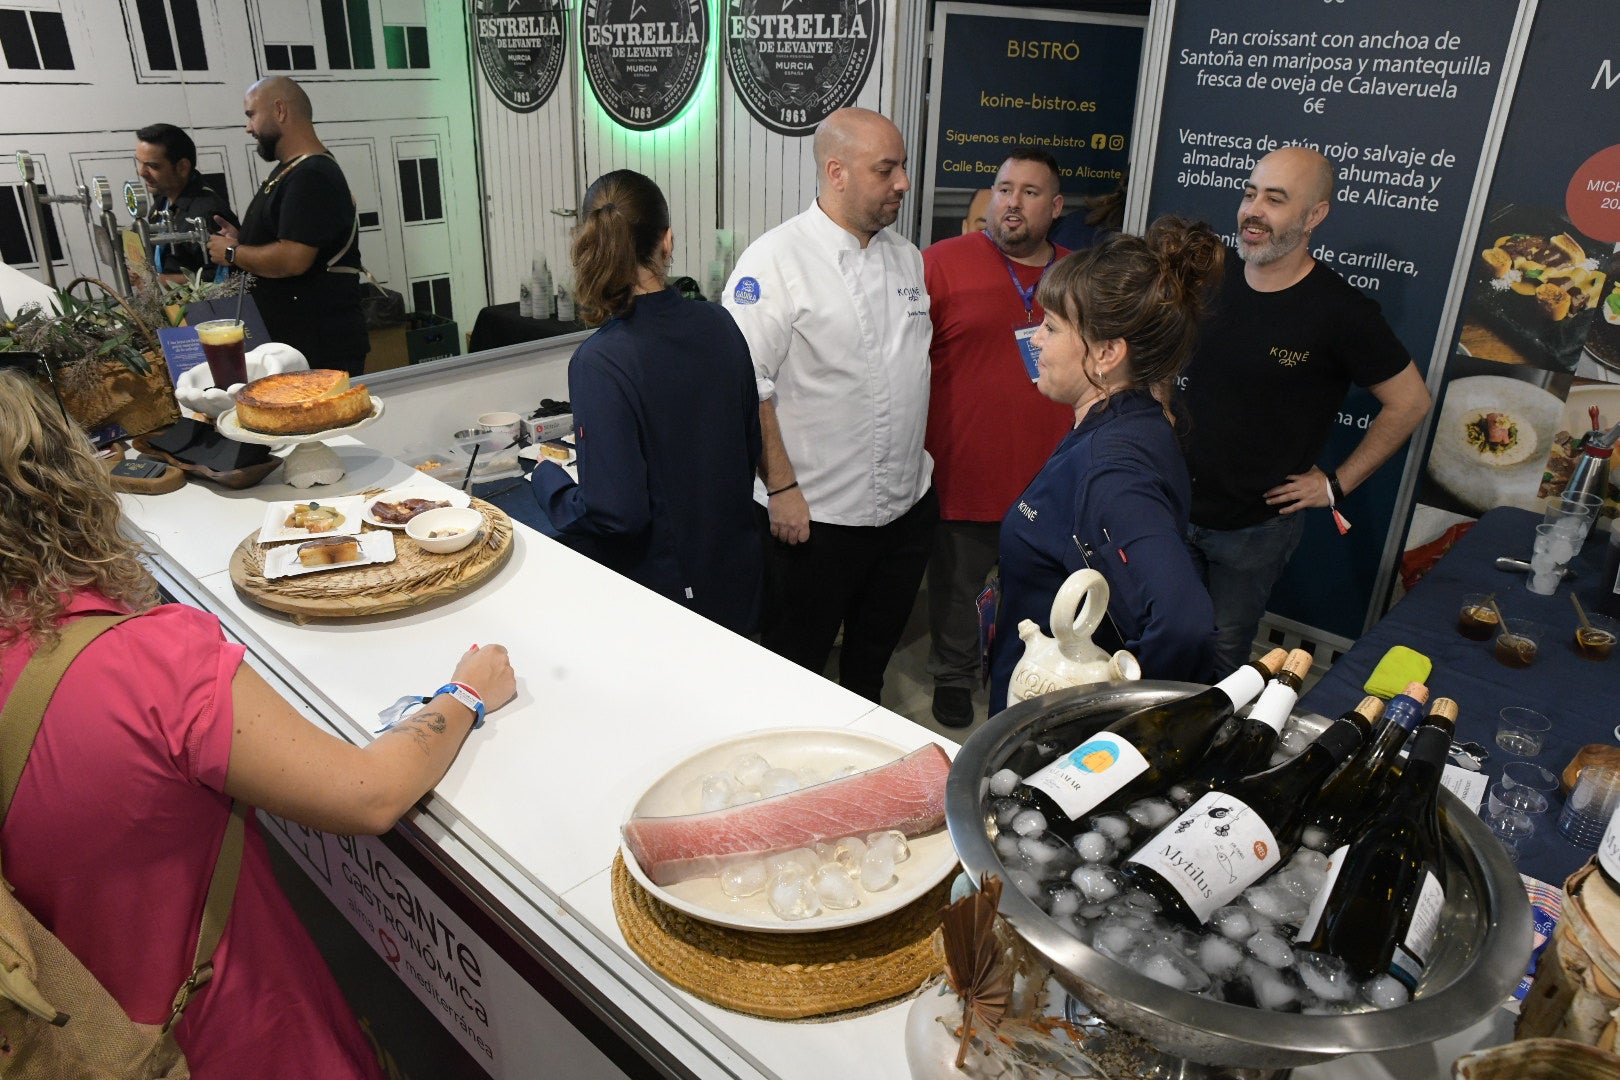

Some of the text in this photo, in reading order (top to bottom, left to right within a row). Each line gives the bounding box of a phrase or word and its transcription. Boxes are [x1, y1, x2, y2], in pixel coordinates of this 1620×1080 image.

[478, 16, 560, 38] ESTRELLA
[587, 22, 700, 45] ESTRELLA
[730, 14, 867, 39] ESTRELLA
[497, 38, 541, 48] DE LEVANTE
[759, 41, 834, 54] DE LEVANTE
[1007, 39, 1080, 60] BISTRÓ
[1209, 28, 1461, 50] Pan croissant con anchoa de
[612, 46, 673, 58] DE LEVANTE
[775, 61, 814, 70] MURCIA
[1180, 48, 1491, 78] Santoña en mariposa y mantequilla
[1197, 69, 1457, 98] fresca de oveja de Calaveruela
[980, 91, 1097, 112] koine-bistro.es
[1303, 97, 1326, 114] 6€
[630, 106, 651, 119] 1963
[780, 108, 807, 123] 1963
[1002, 135, 1016, 144] en
[1019, 133, 1086, 148] koine.bistro
[1179, 128, 1252, 149] Ventresca
[1256, 135, 1278, 151] de
[1323, 142, 1359, 162] rojo
[1362, 144, 1426, 168] salvaje
[1430, 148, 1456, 168] de
[943, 159, 973, 172] Calle
[975, 161, 998, 173] Baz
[1076, 166, 1122, 179] Alicante
[1338, 164, 1424, 188] ahumada
[1427, 176, 1442, 193] y
[1337, 185, 1360, 203] de
[1363, 188, 1440, 212] Alicante
[1312, 244, 1419, 277] de carrillera,
[1348, 274, 1380, 290] con
[1159, 844, 1213, 899] Mytilus
[347, 897, 494, 1060] alma mediterránea
